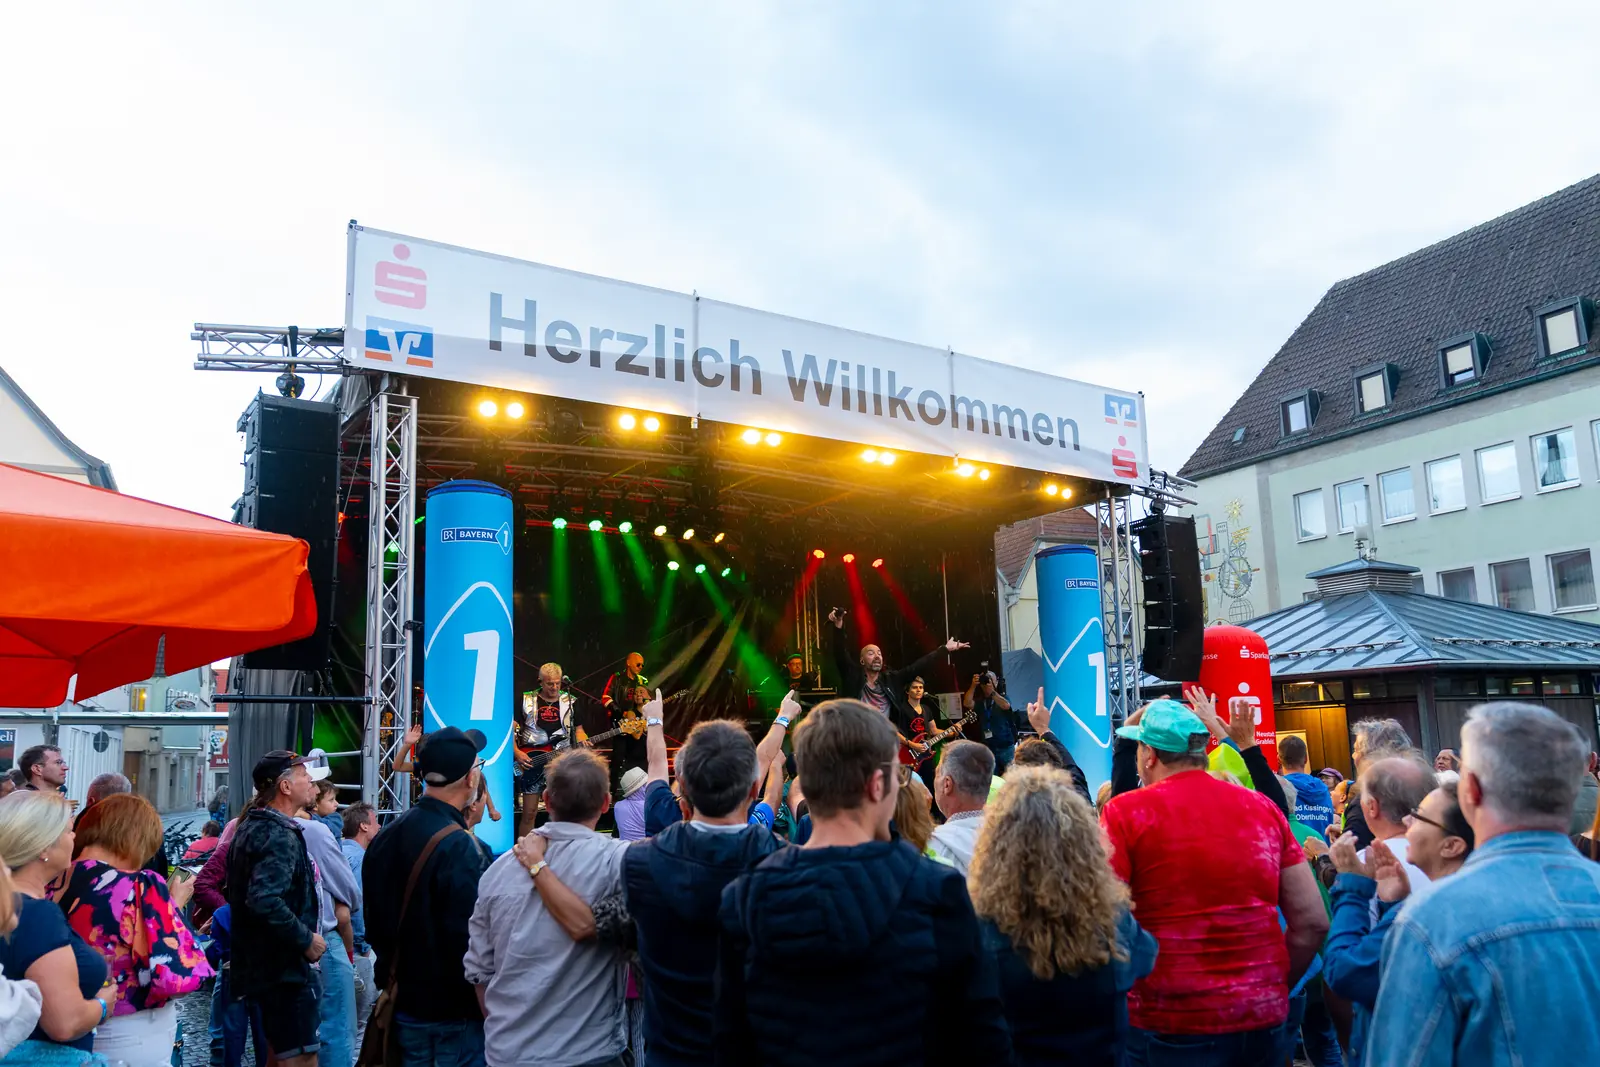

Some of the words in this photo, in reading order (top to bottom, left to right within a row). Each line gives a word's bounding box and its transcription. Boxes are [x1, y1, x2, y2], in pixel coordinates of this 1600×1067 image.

[489, 291, 762, 396] Herzlich
[781, 349, 1081, 452] Willkommen
[443, 530, 454, 540] BR
[459, 530, 493, 539] BAYERN
[463, 629, 500, 721] 1
[1087, 651, 1107, 716] 1
